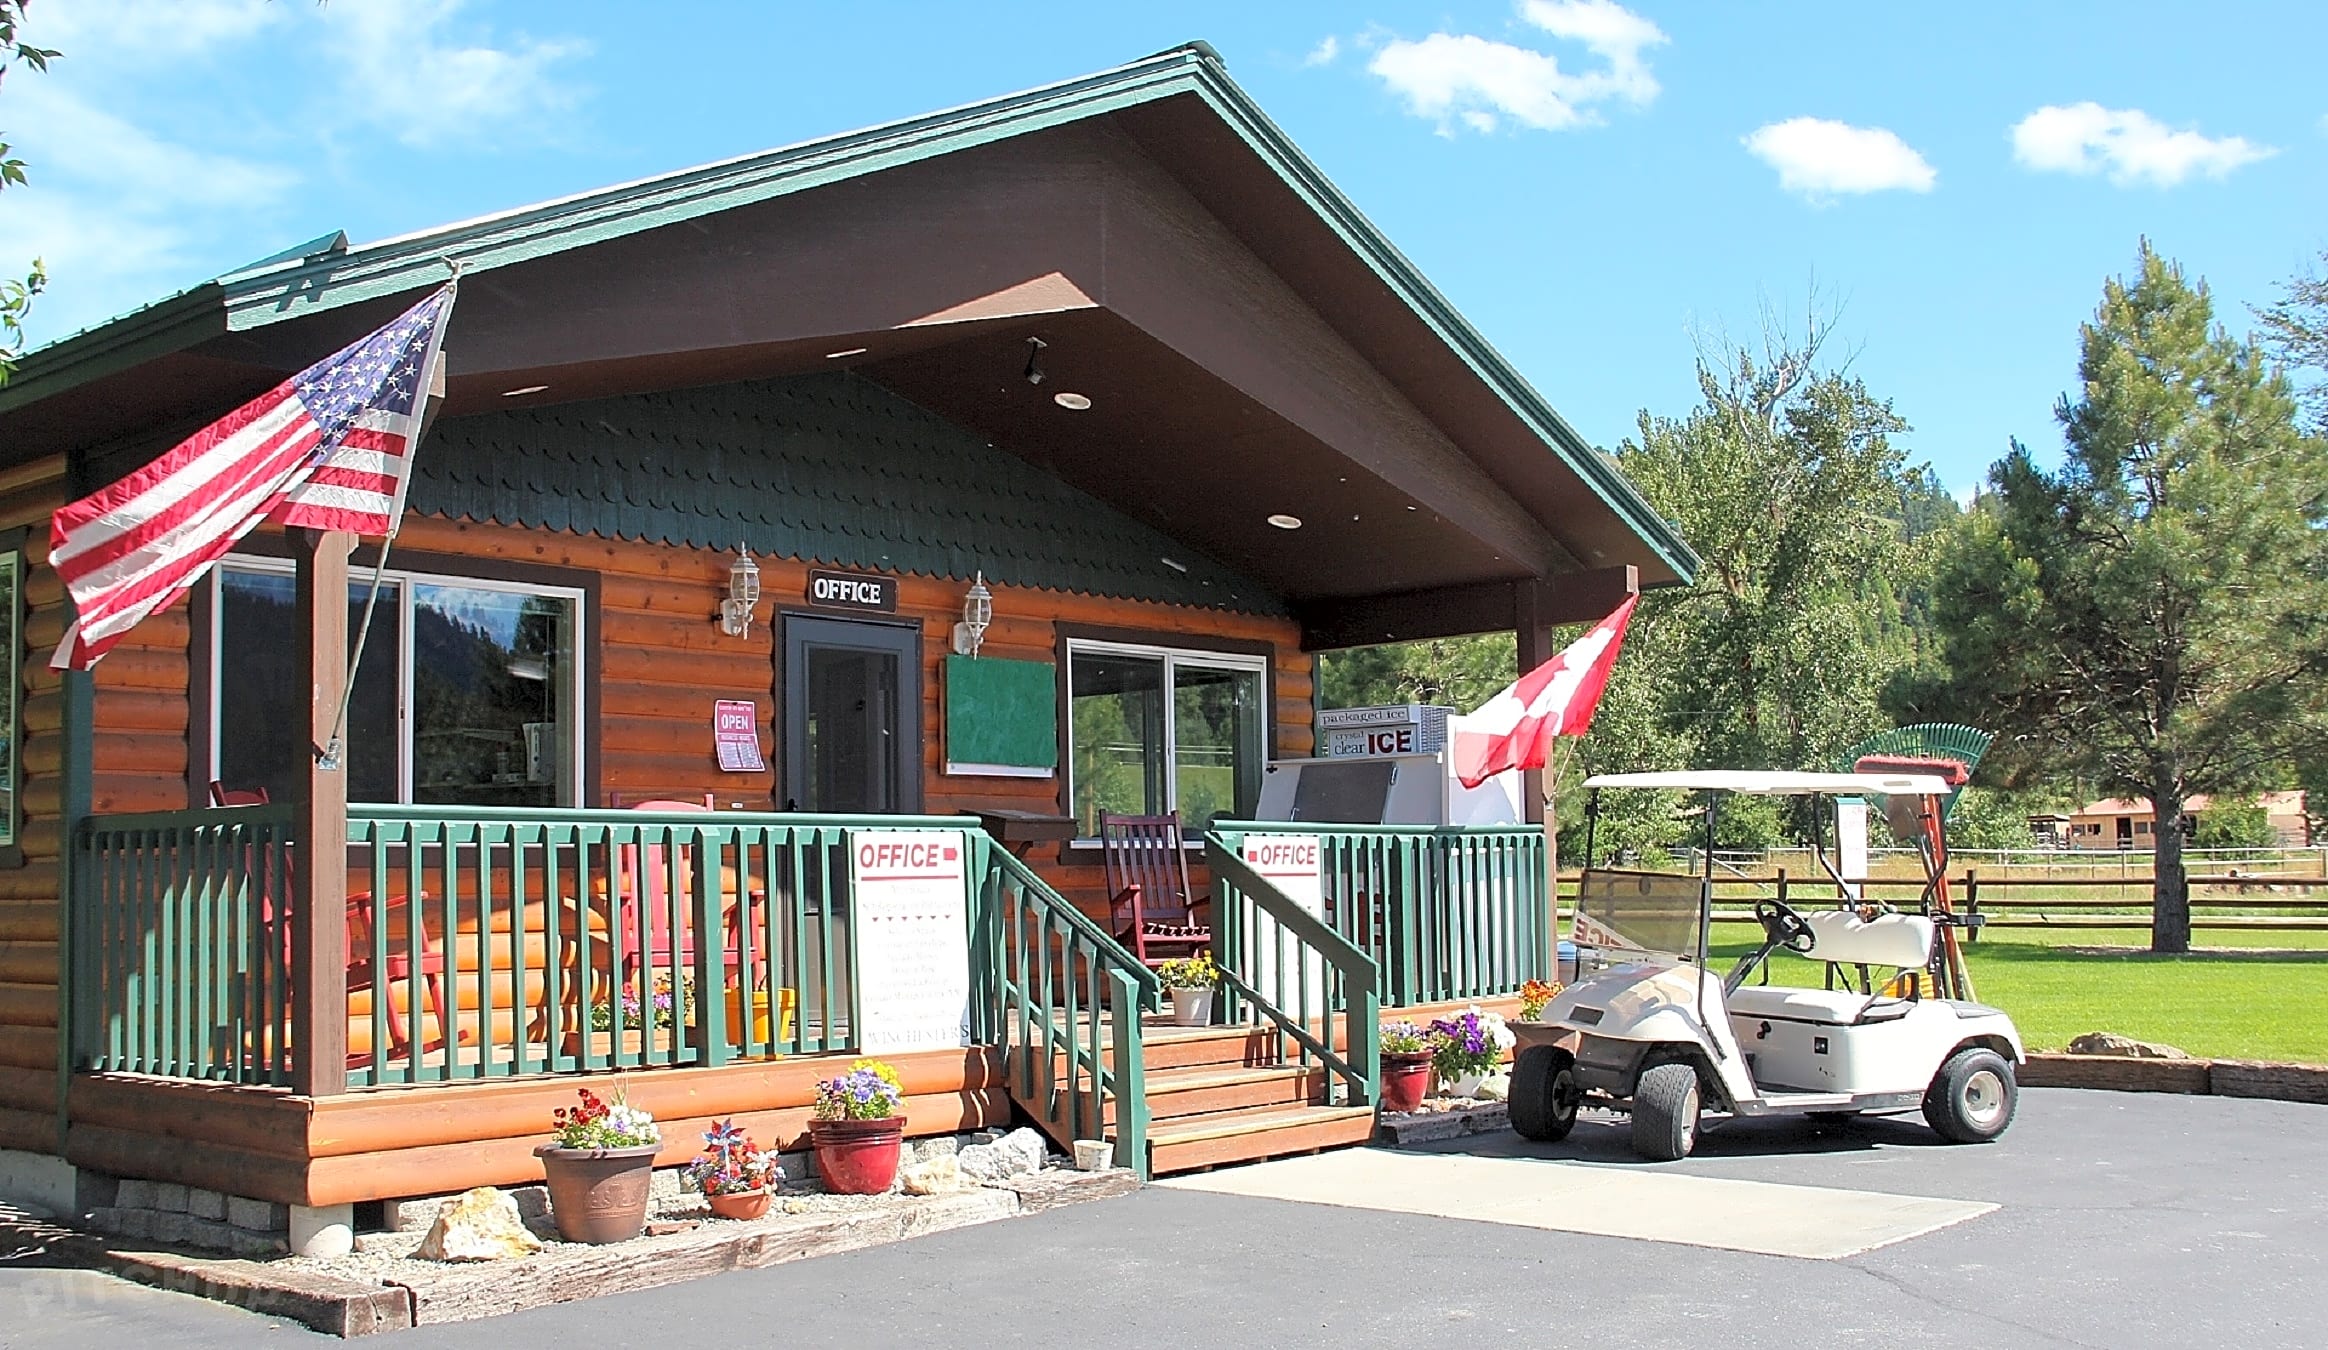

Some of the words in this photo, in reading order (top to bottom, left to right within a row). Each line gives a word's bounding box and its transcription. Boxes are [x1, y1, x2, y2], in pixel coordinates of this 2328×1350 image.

[814, 578, 881, 604] OFFICE
[721, 714, 748, 730] OPEN
[1323, 711, 1382, 726] packaged
[1387, 709, 1405, 719] ice
[1334, 741, 1365, 755] clear
[1368, 729, 1412, 755] ICE
[860, 844, 939, 868] OFFICE
[1261, 845, 1317, 865] OFFICE
